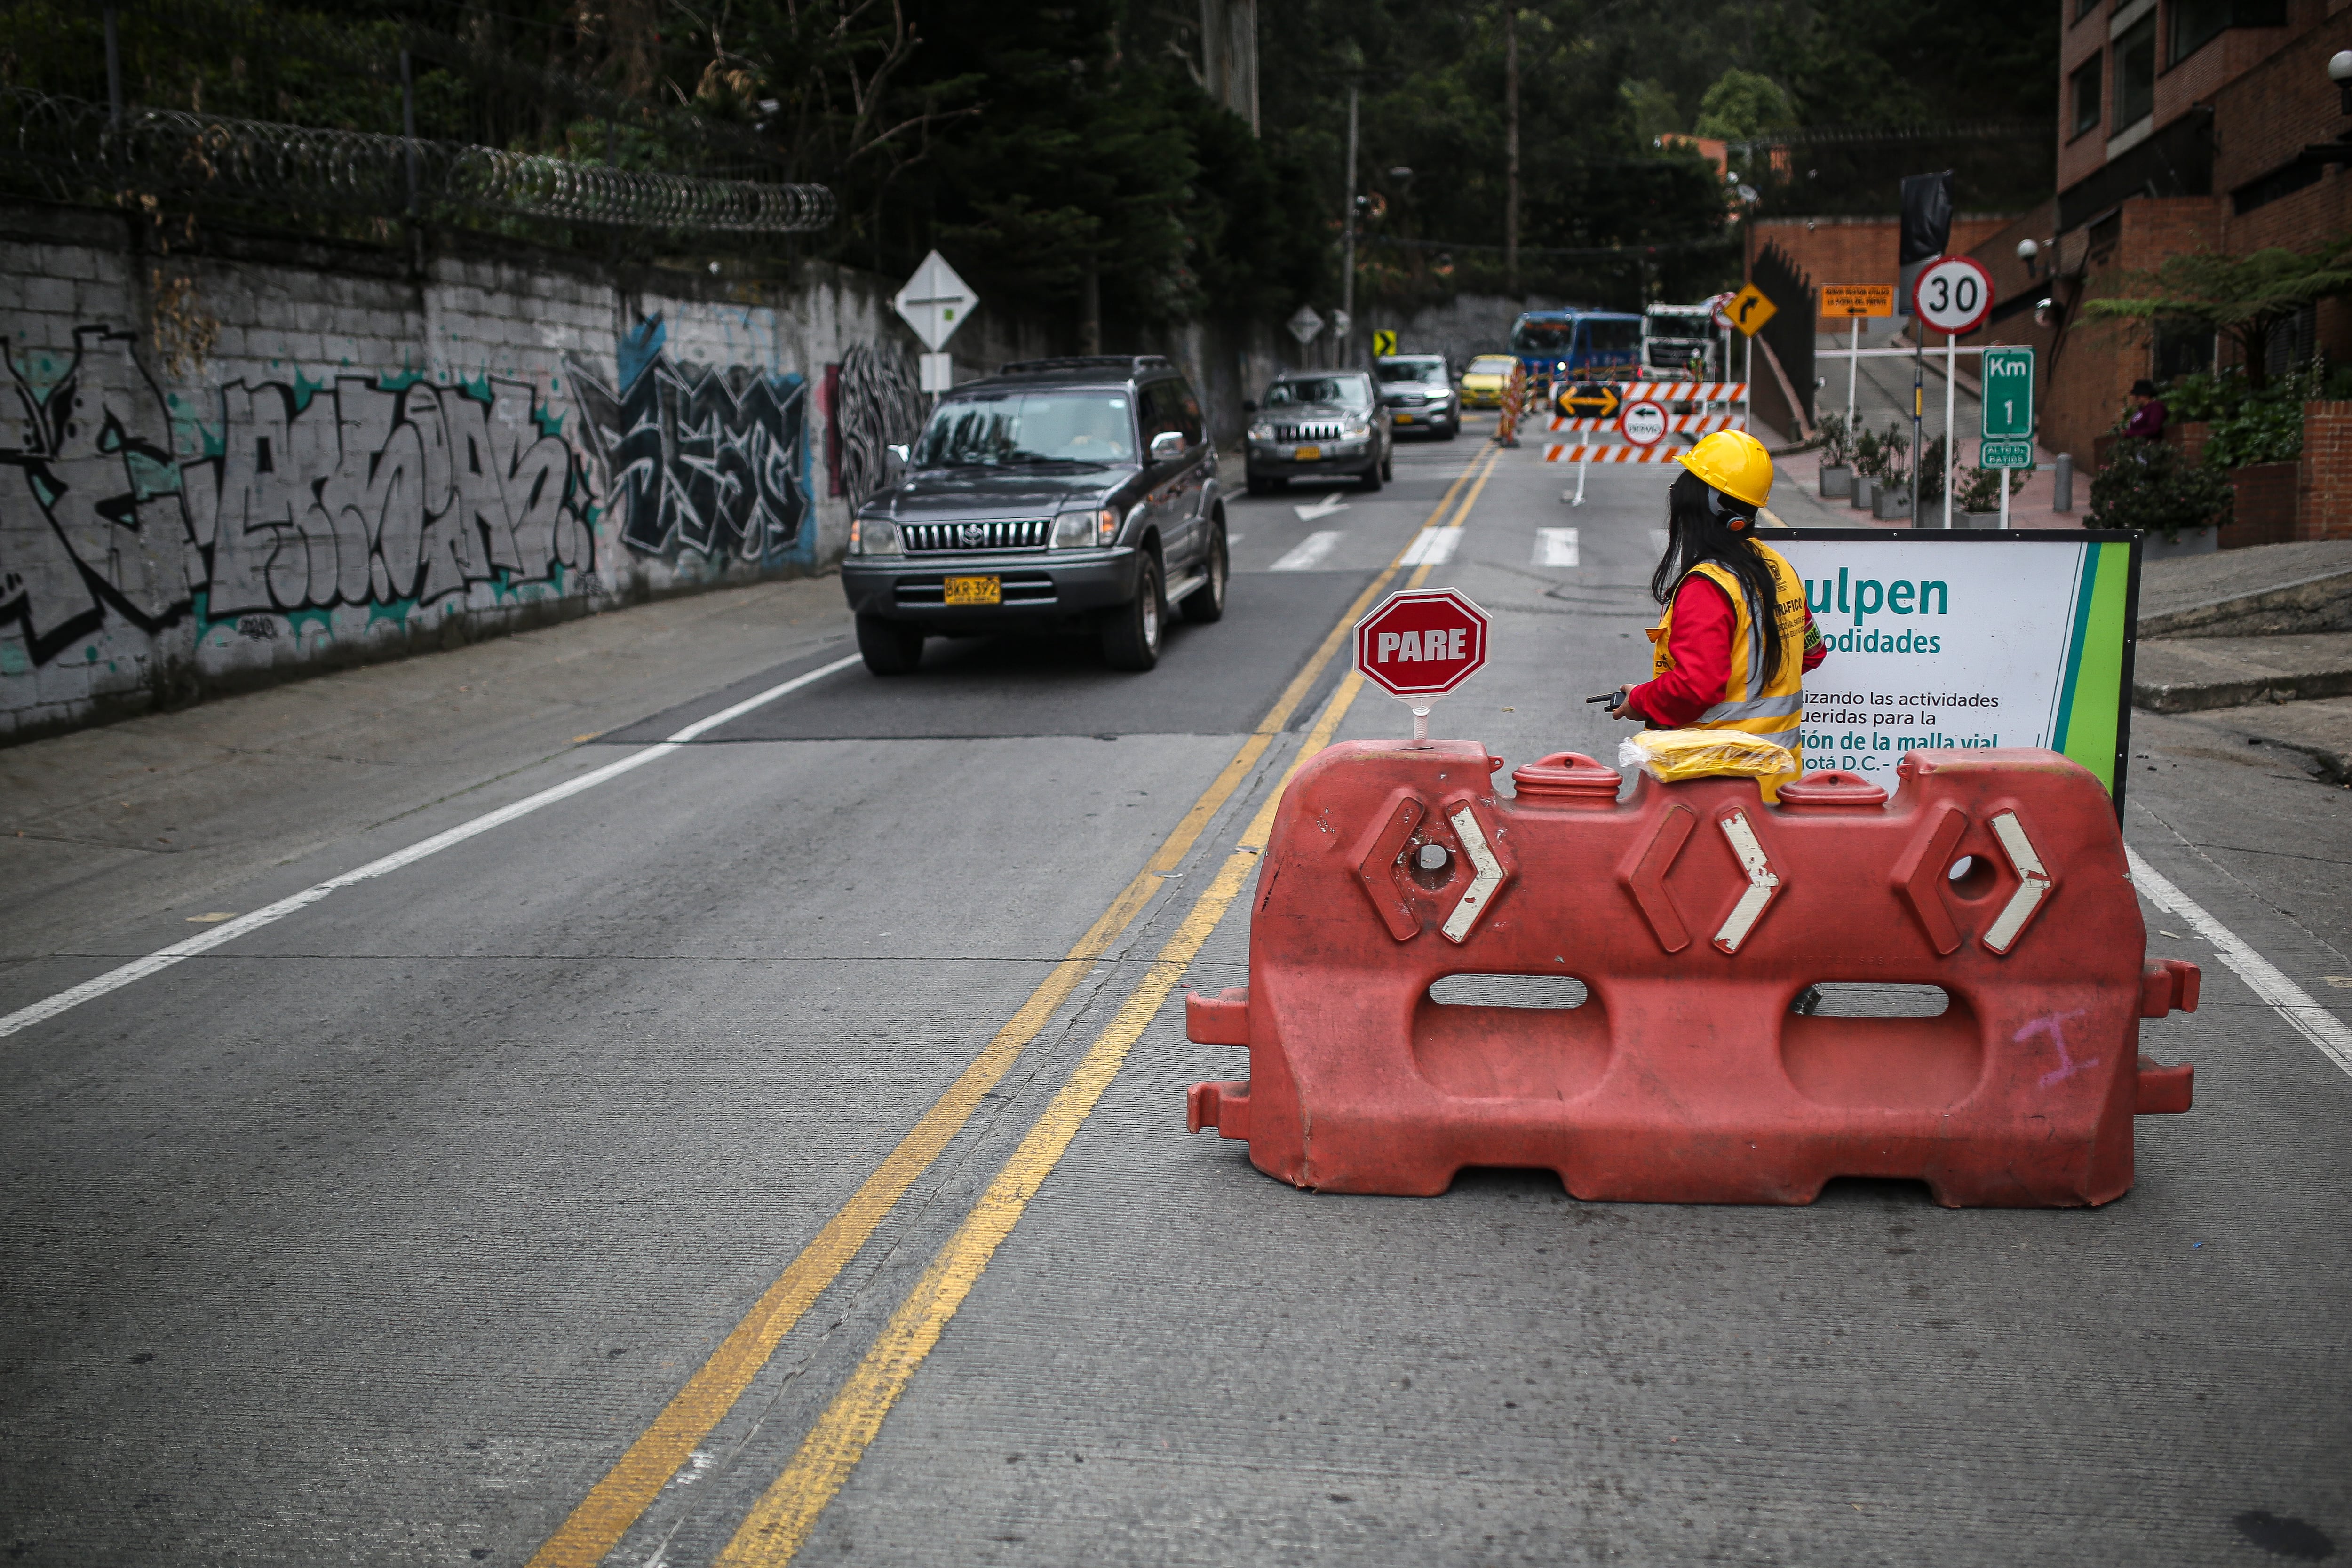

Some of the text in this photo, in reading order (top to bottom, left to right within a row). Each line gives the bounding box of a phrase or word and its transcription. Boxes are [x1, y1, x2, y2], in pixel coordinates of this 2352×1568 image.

[1929, 276, 1978, 312] 30
[1990, 357, 2026, 377] Km
[2004, 400, 2013, 425] 1
[1805, 567, 1948, 626] ulpen
[1378, 628, 1467, 663] PARE
[1823, 628, 1941, 653] odidades
[1802, 690, 1999, 707] lizando las actividades
[1801, 709, 1936, 728] ueridas para la
[1802, 730, 1998, 751] ión de la malla vial
